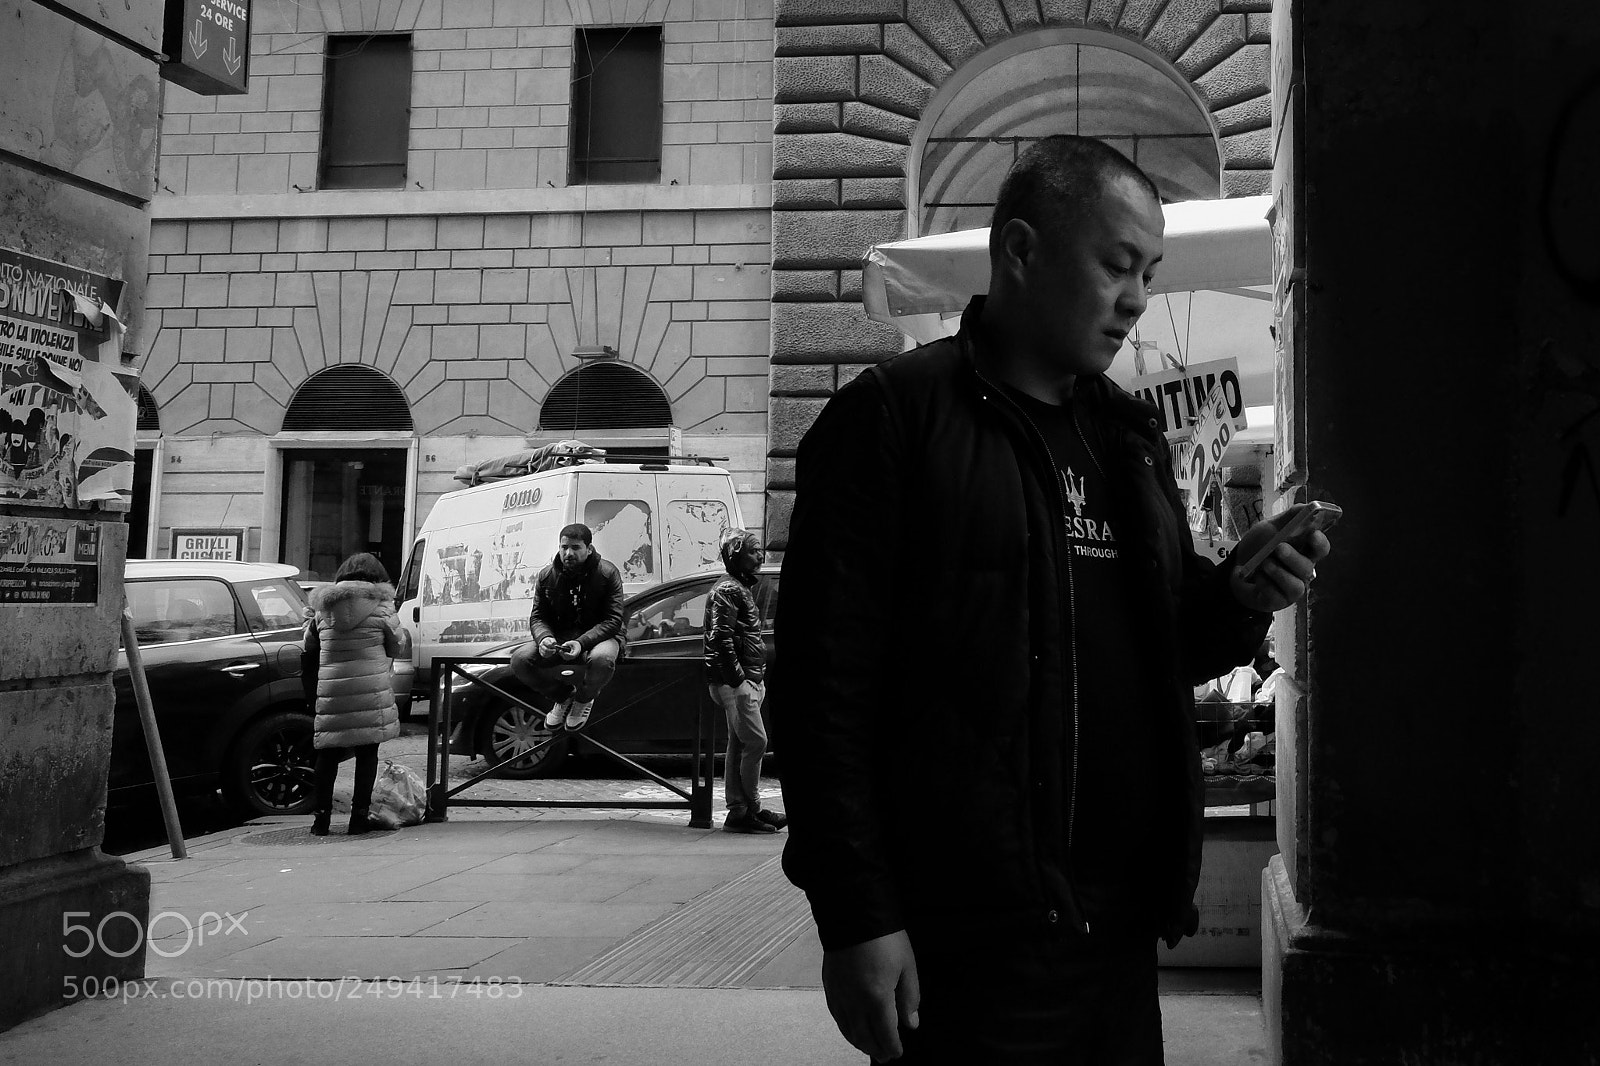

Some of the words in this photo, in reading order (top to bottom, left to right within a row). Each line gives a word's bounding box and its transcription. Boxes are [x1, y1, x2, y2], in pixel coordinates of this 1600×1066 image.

[200, 4, 213, 21] 24
[214, 12, 234, 32] ORE
[26, 269, 98, 301] NAZIONALE
[16, 324, 29, 342] LA
[30, 328, 75, 352] VIOLENZA
[1135, 370, 1242, 434] NTIMO
[425, 454, 436, 463] 56
[185, 537, 229, 550] GRILLI
[1073, 544, 1119, 559] THROUGH
